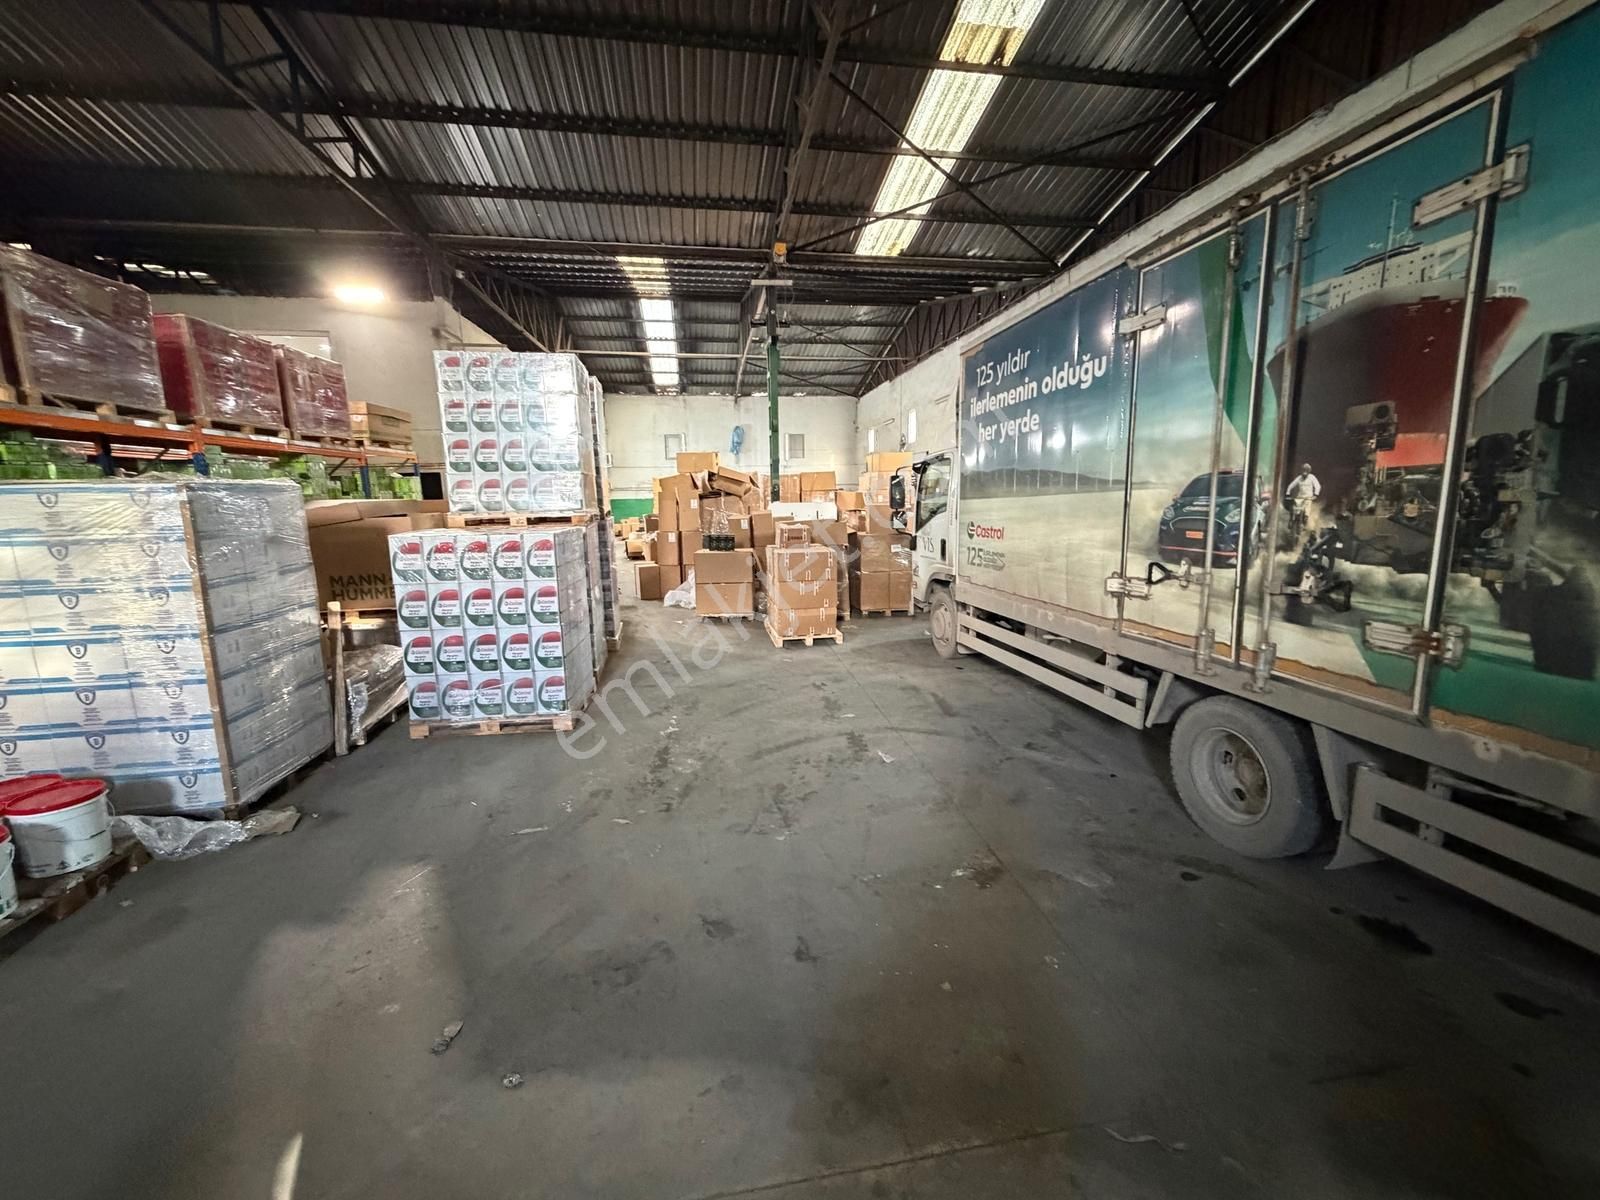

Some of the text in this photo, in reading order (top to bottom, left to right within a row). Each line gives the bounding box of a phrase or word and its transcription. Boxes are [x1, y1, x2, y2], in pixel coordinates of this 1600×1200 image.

[970, 353, 1106, 418] ilerlemenin olduğu
[976, 348, 1030, 388] 125 yıldır
[978, 408, 1040, 444] her yerde
[975, 524, 1004, 540] Castrol
[967, 547, 983, 567] 125
